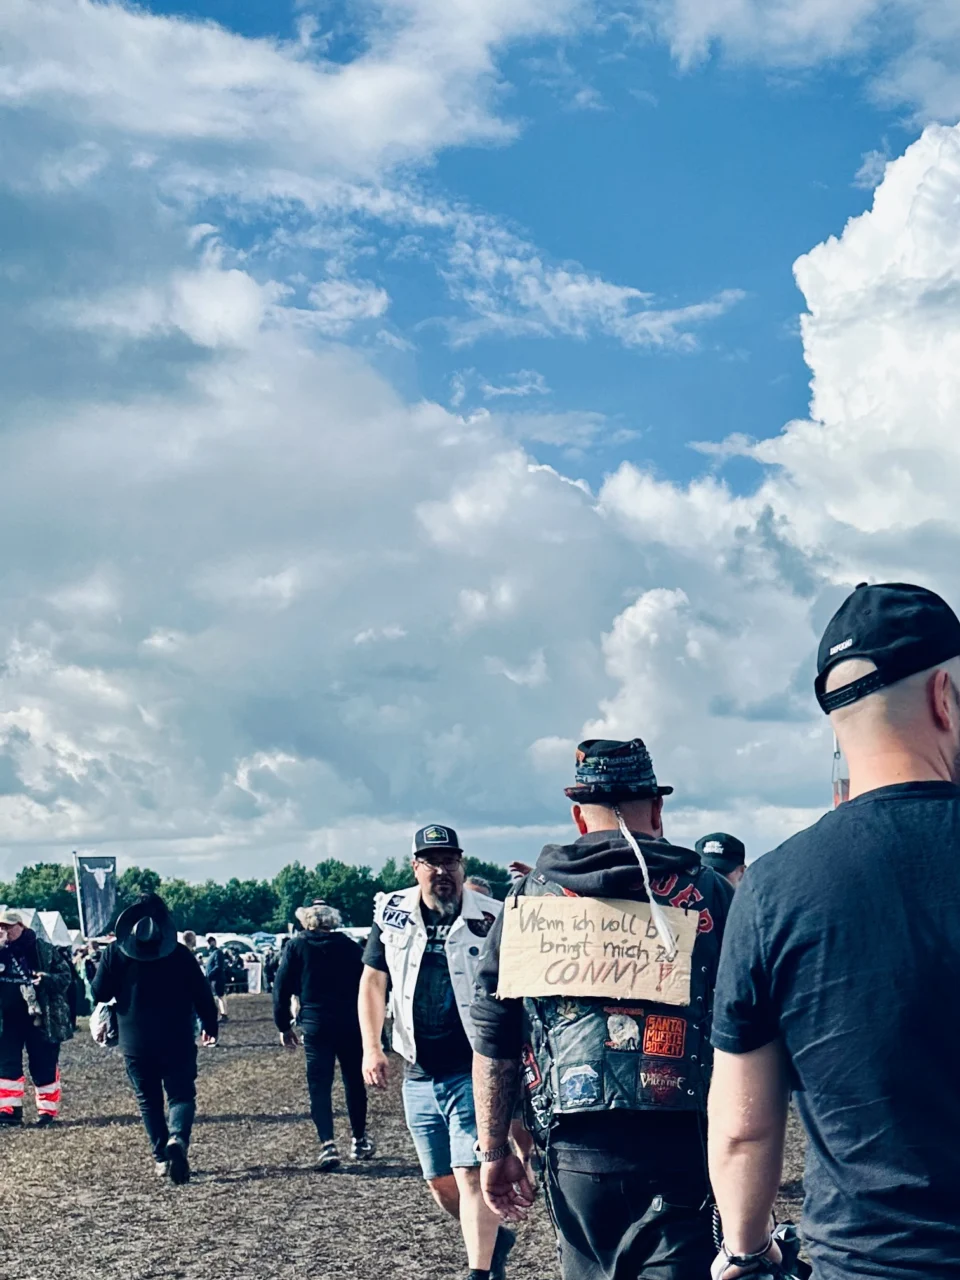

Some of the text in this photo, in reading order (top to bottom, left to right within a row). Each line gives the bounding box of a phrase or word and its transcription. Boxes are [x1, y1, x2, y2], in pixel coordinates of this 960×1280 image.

[519, 902, 564, 934] Wenn
[573, 908, 595, 932] ich
[601, 914, 637, 937] voll
[603, 939, 649, 964] mich
[648, 1016, 683, 1032] SANTA
[646, 1029, 683, 1044] MUERTE
[645, 1041, 682, 1056] SOCIETY
